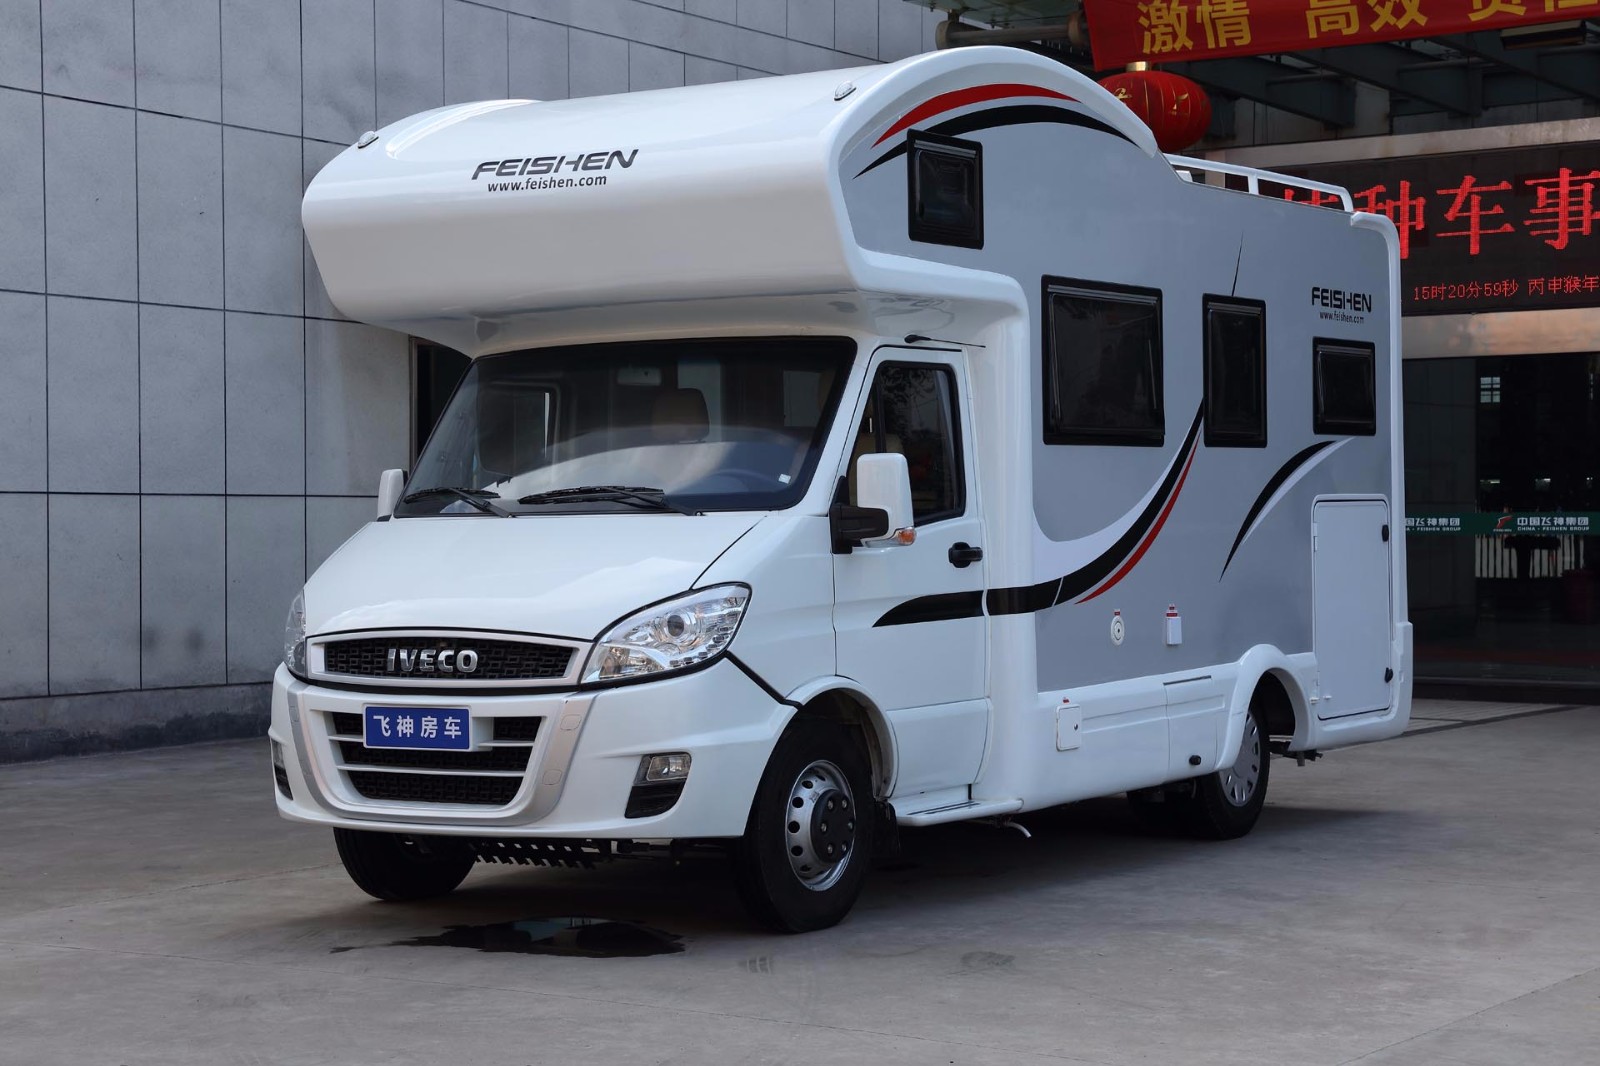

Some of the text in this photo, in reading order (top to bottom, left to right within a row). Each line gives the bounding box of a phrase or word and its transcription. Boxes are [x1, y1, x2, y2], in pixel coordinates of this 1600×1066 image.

[1138, 0, 1251, 54] 激情
[471, 149, 639, 180] FEISHEN
[487, 175, 607, 192] www.feishen.com
[1312, 286, 1372, 313] FEISHEN
[1414, 275, 1600, 301] 15时20分59秒 丙申猴年
[1320, 310, 1364, 324] www.feishen.com
[1517, 516, 1589, 526] 中国飞神集团
[387, 648, 478, 673] IVECO
[373, 715, 461, 739] 飞神房车
